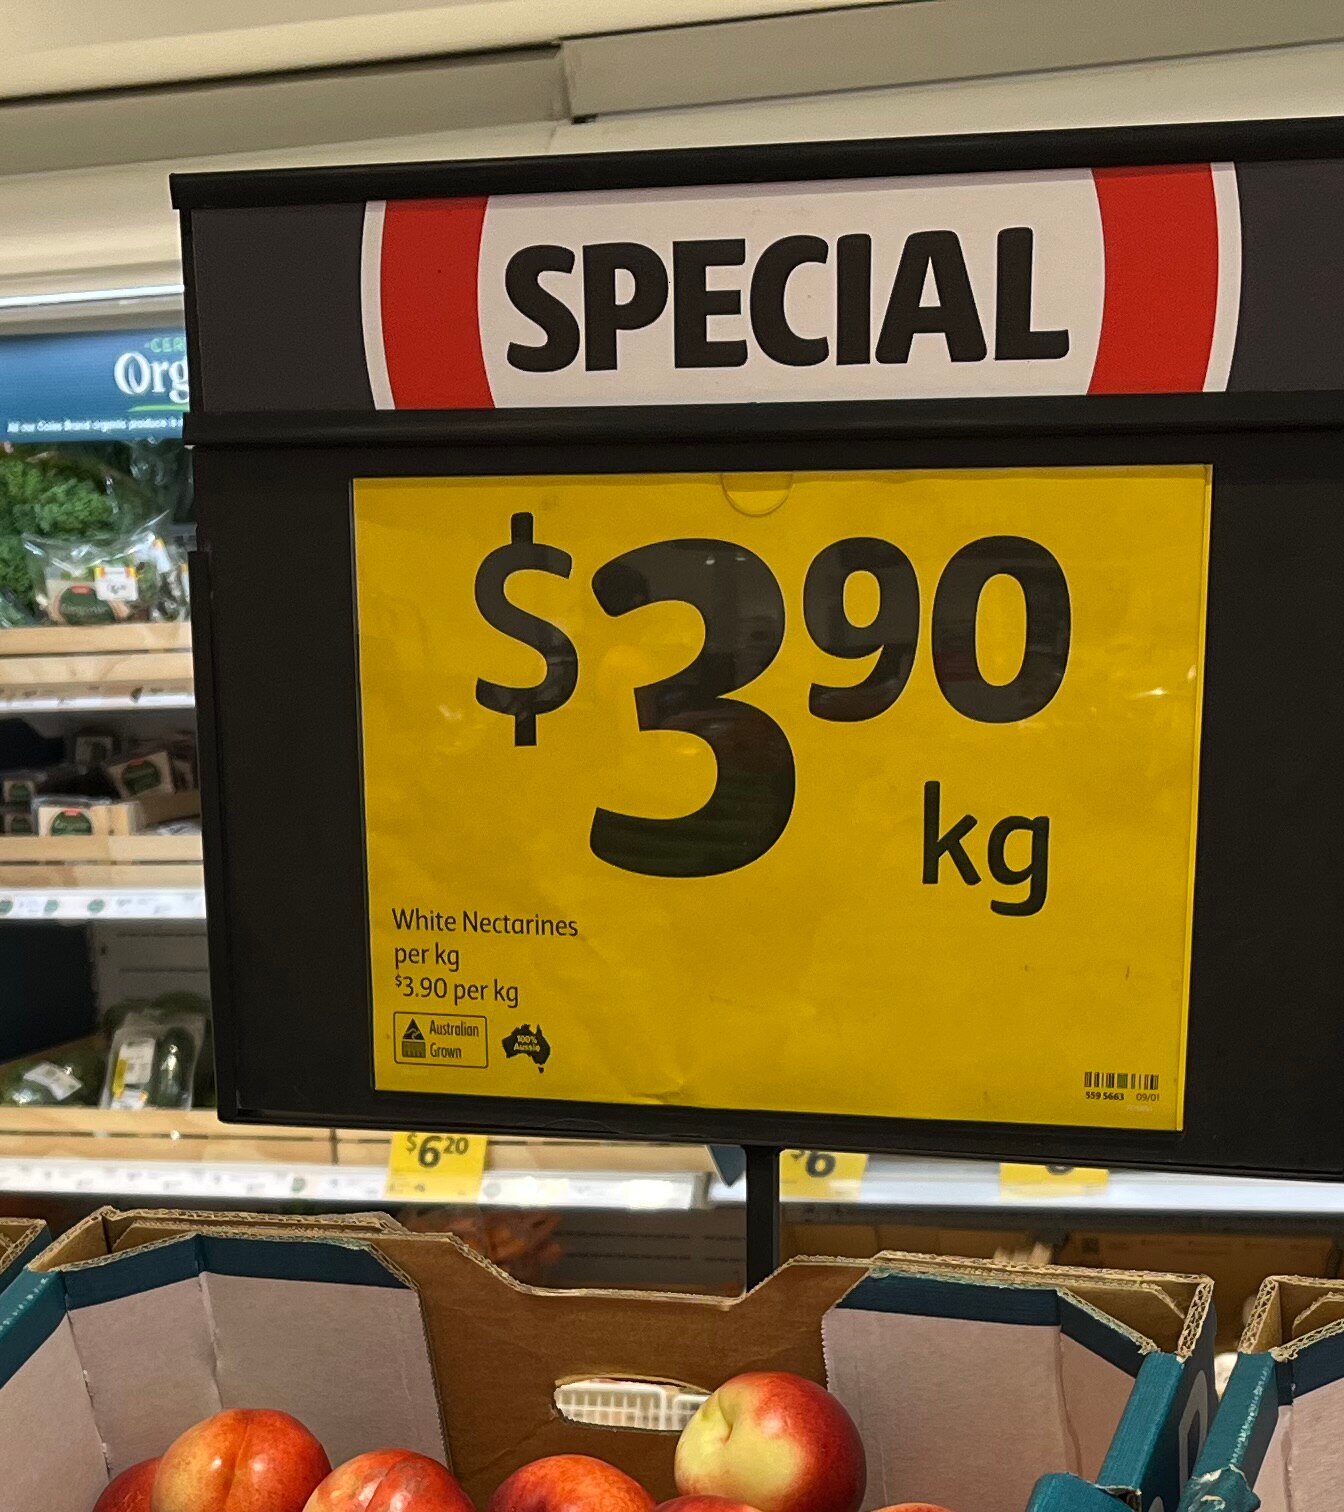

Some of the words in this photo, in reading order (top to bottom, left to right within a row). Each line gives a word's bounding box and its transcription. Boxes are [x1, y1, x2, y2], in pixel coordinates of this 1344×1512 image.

[504, 226, 1070, 373] SPECIAL
[921, 780, 1050, 917] kg
[391, 907, 457, 932] White
[462, 910, 578, 937] Nectarines
[394, 946, 430, 970] per
[434, 942, 460, 972] kg
[394, 973, 448, 999] $3.90
[454, 982, 488, 1006] per
[494, 978, 519, 1008] kg
[429, 1019, 480, 1038] Australian
[430, 1042, 462, 1059] Grown
[1135, 1092, 1160, 1102] 09/01
